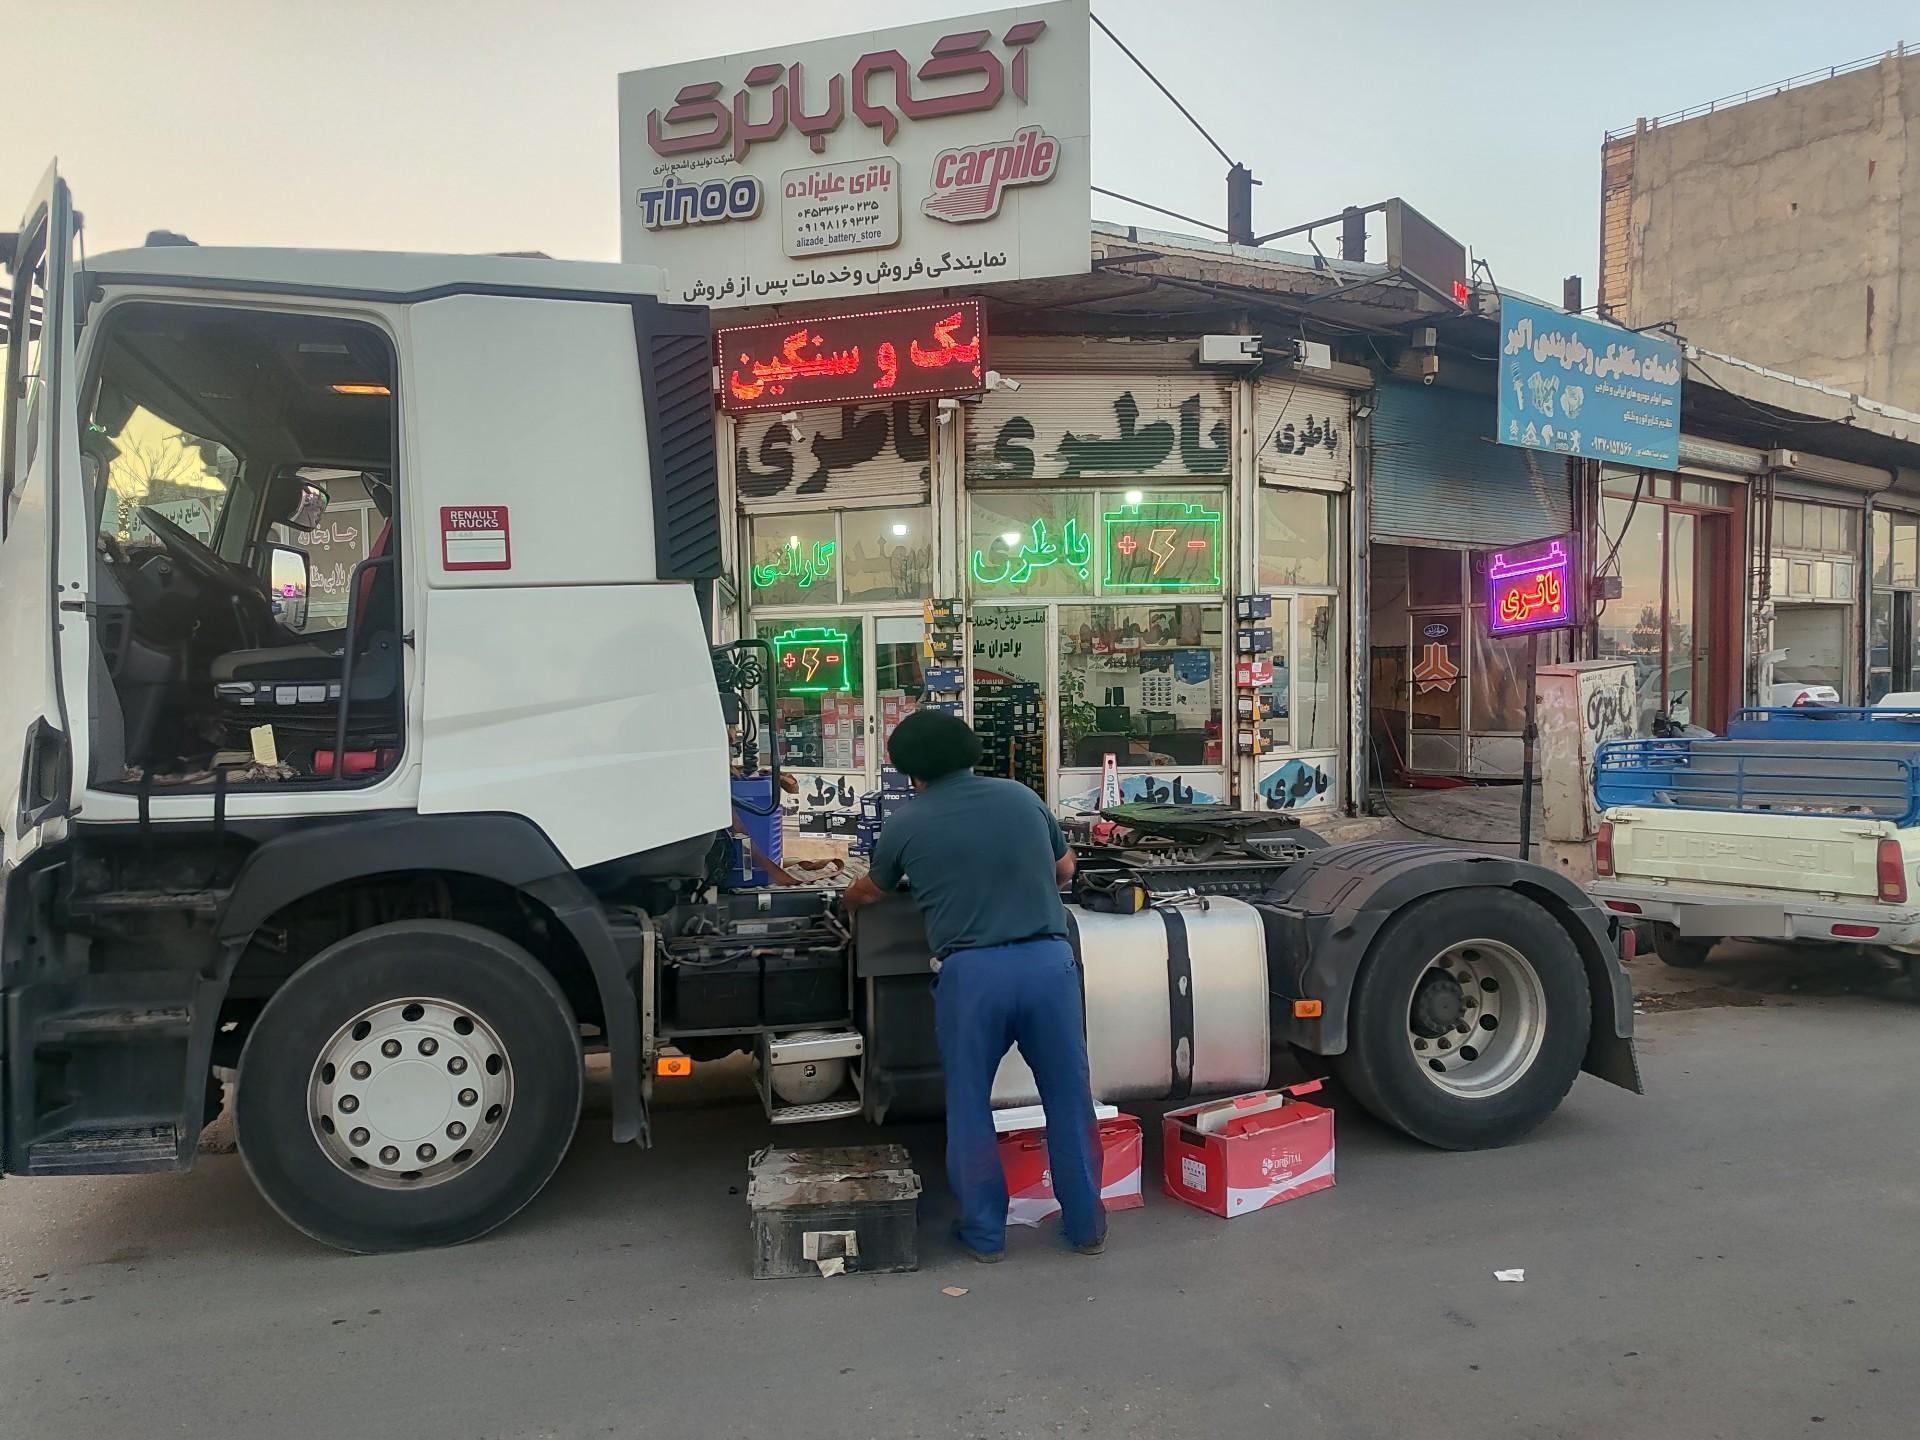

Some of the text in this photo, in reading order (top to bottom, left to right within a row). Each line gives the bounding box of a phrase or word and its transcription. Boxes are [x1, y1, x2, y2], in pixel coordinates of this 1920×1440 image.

[647, 60, 844, 163] باتری
[653, 163, 670, 176] باتری
[936, 131, 1055, 214] carpile
[785, 165, 891, 202] باتری علیزاده
[796, 229, 882, 248] alizade_battery_store
[866, 257, 924, 284] فروش
[926, 249, 1007, 276] نمایندگی
[683, 277, 734, 302] فروش
[737, 276, 750, 297] از
[755, 276, 788, 297] پس
[731, 328, 860, 400] سنگین
[873, 342, 897, 389] و
[450, 510, 499, 520] RENAULT
[450, 519, 499, 528] TRUCKS
[1500, 571, 1561, 622] باتری
[1000, 612, 1022, 630] فروش
[989, 638, 1022, 659] برادران
[1266, 764, 1328, 810] باطری
